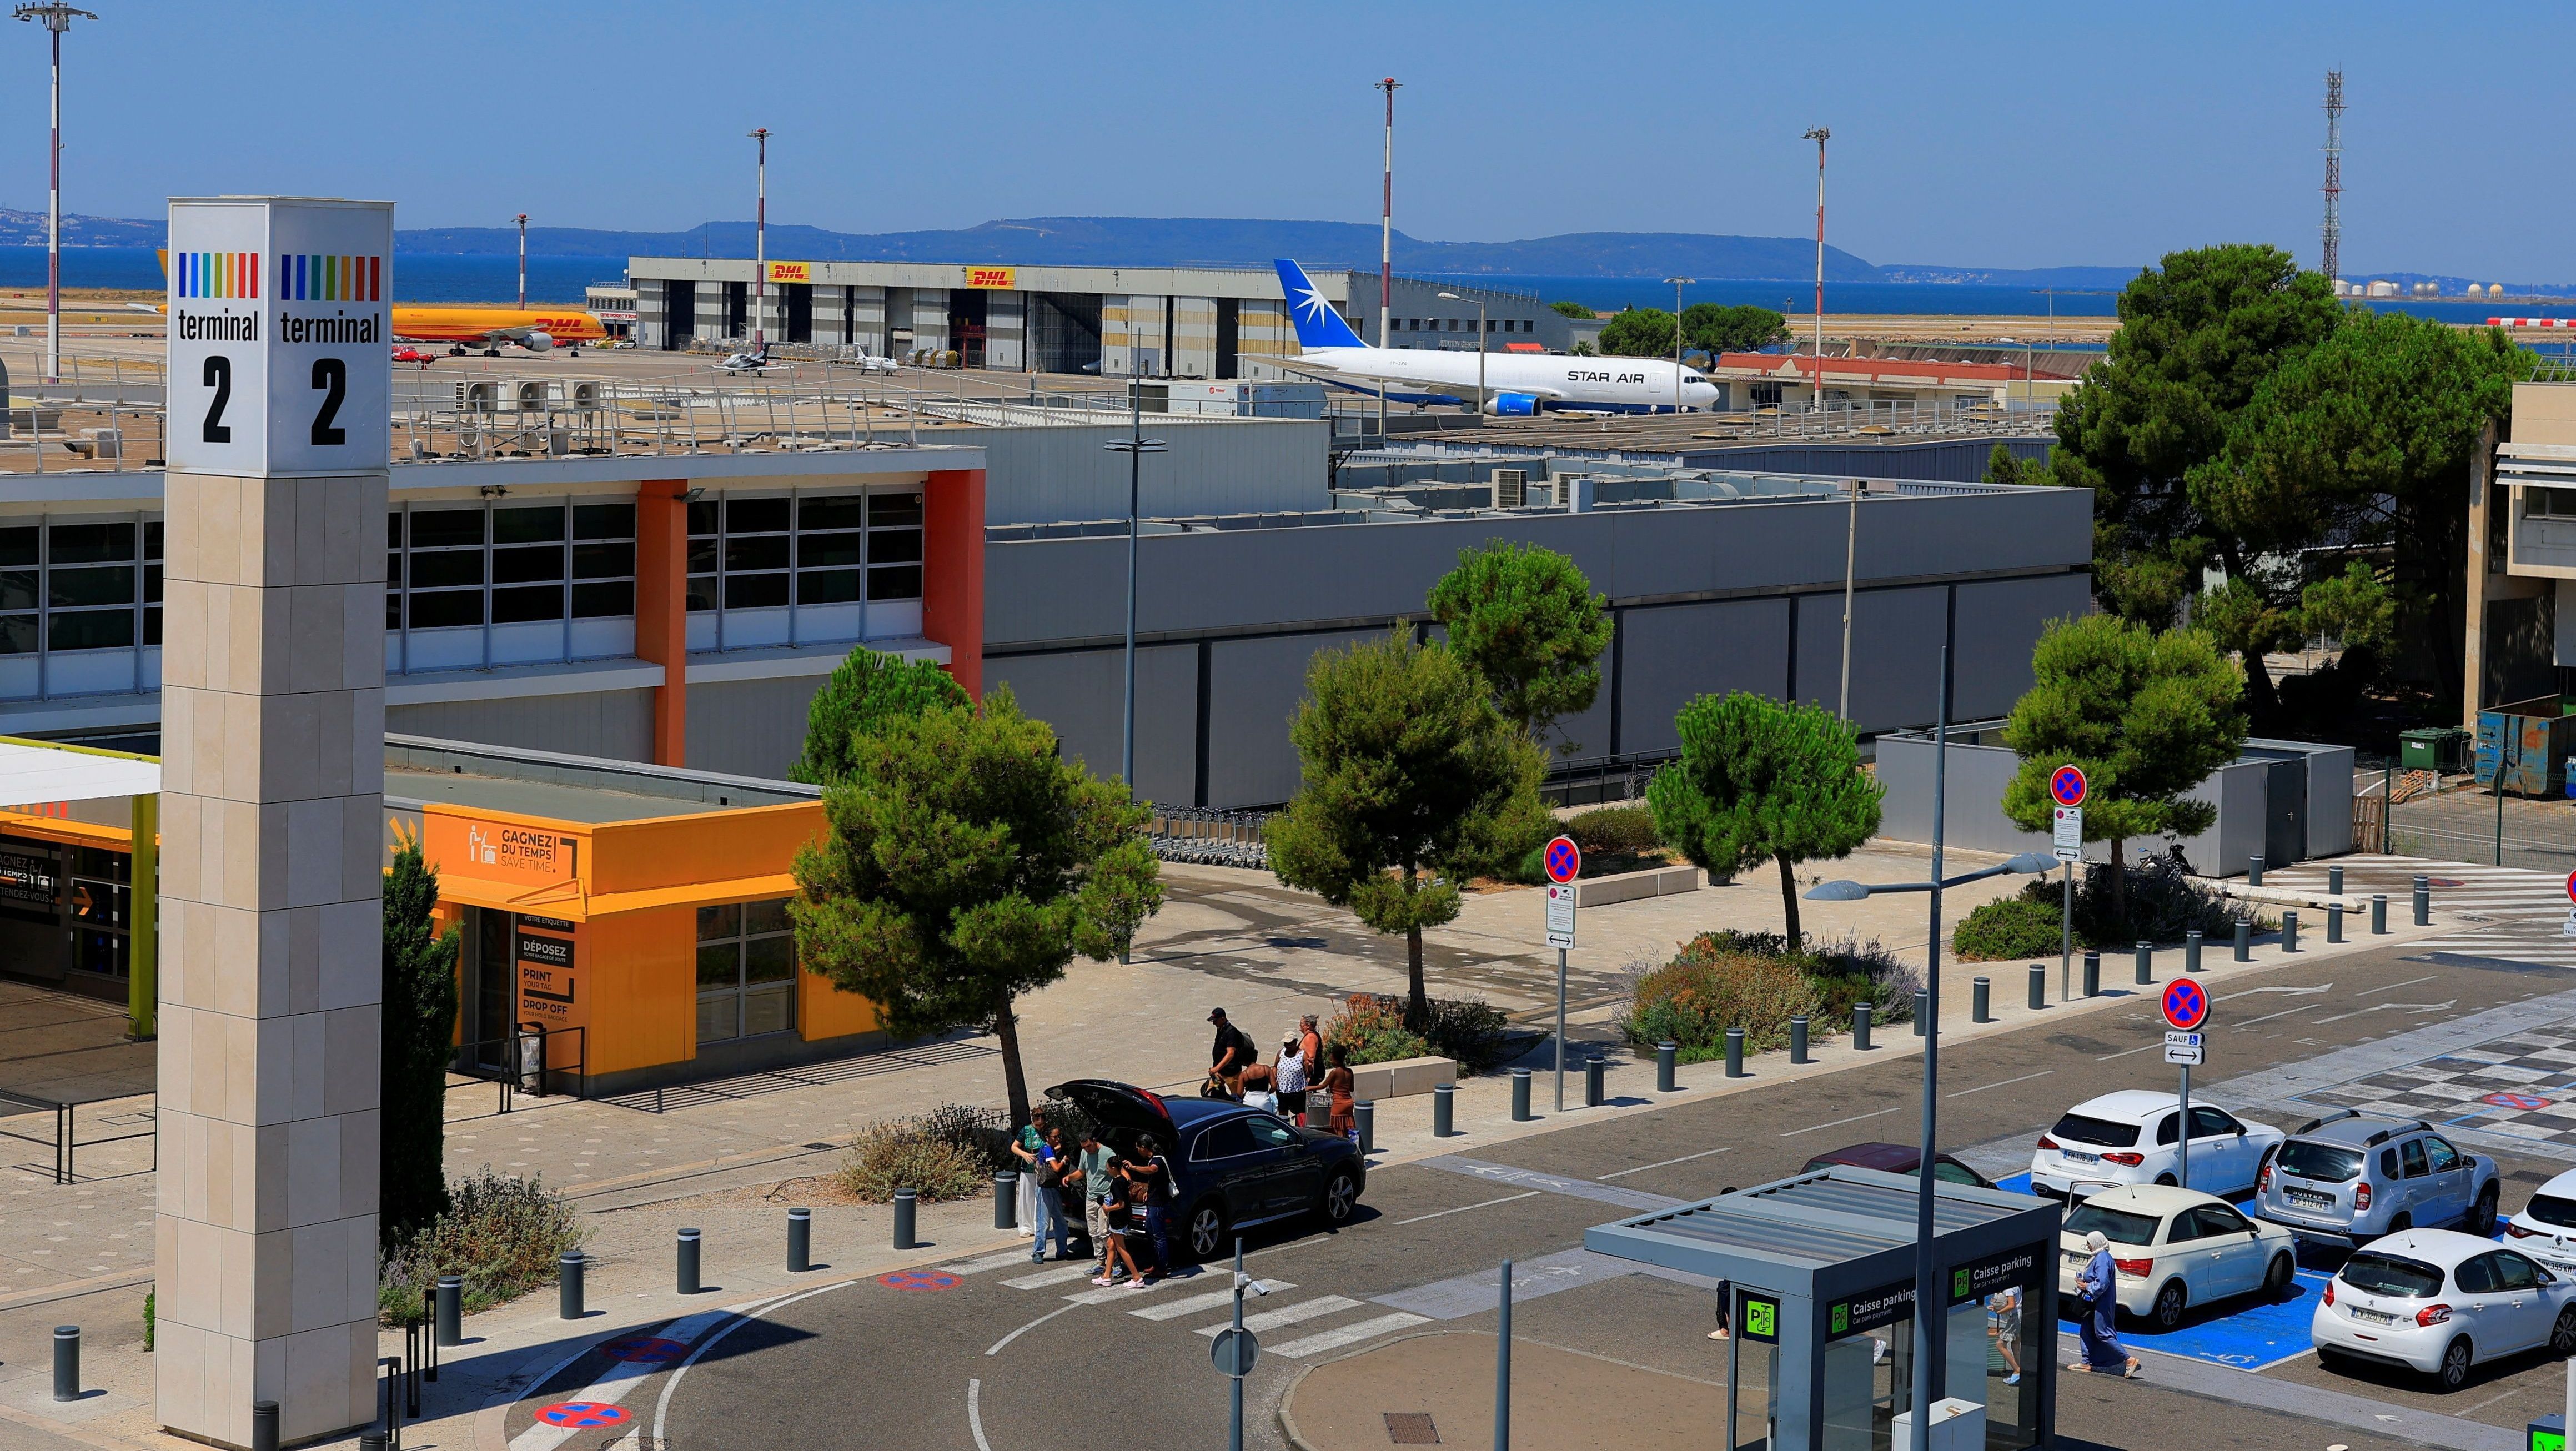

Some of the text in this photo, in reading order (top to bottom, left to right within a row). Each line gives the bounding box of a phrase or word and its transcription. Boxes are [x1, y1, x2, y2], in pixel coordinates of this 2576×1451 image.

[774, 265, 804, 279] DHL
[973, 270, 1008, 285] DHL
[178, 308, 258, 342] terminal
[280, 310, 379, 343] terminal
[534, 318, 584, 333] DHL
[1568, 371, 1644, 384] STAR AIR
[203, 355, 231, 443] 2
[311, 358, 346, 445] 2
[501, 830, 552, 848] GAGNEZ
[501, 844, 551, 860] DU TEMPS
[501, 856, 551, 872] SAVE TIME
[523, 940, 566, 957] DÉPOSEZ
[523, 968, 552, 982] PRINT
[524, 980, 539, 988] YOUR
[523, 999, 568, 1015] DROP OFF
[2167, 1034, 2188, 1043] SAUF
[2293, 1191, 2323, 1200] DUSTER
[1974, 1255, 2032, 1281] Caisse parking
[1981, 1279, 1991, 1288] park
[1991, 1274, 2010, 1286] payment
[1852, 1288, 1916, 1316] Caisse parking
[1861, 1314, 1872, 1323] park
[1872, 1308, 1892, 1321] payment
